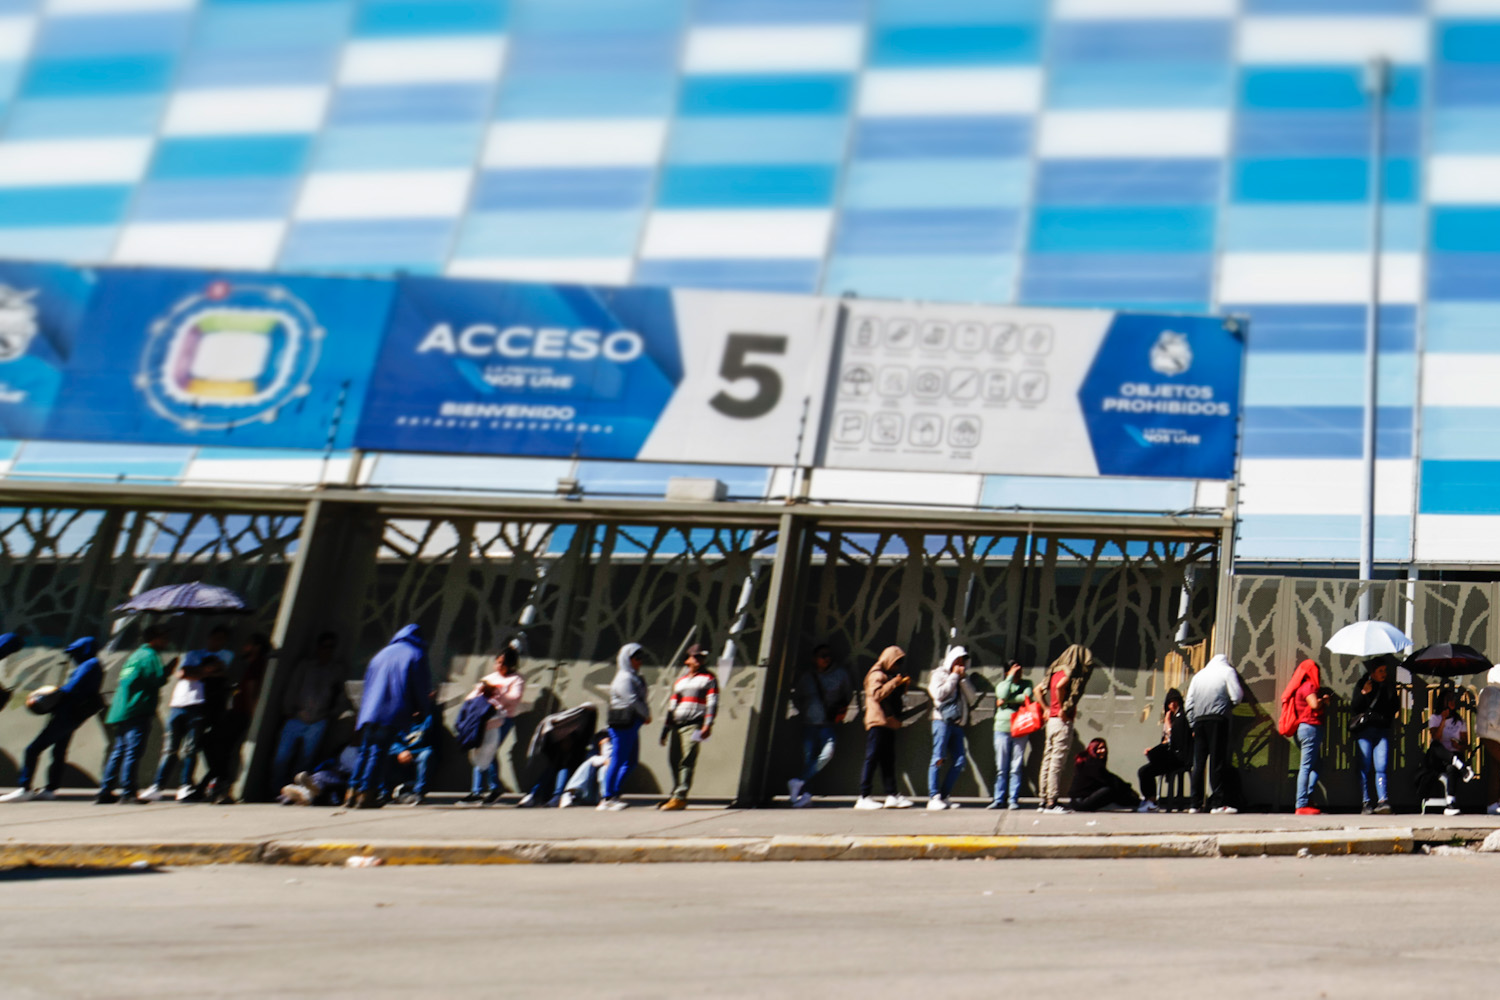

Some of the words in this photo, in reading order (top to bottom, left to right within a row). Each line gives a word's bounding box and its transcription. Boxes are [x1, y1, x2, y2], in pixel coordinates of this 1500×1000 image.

[418, 323, 643, 362] ACCESO
[530, 375, 574, 389] UNE
[708, 332, 789, 420] 5
[1120, 382, 1214, 400] OBJETOS
[440, 402, 575, 420] BIENVENIDO
[1102, 397, 1231, 416] PROHIBIDOS
